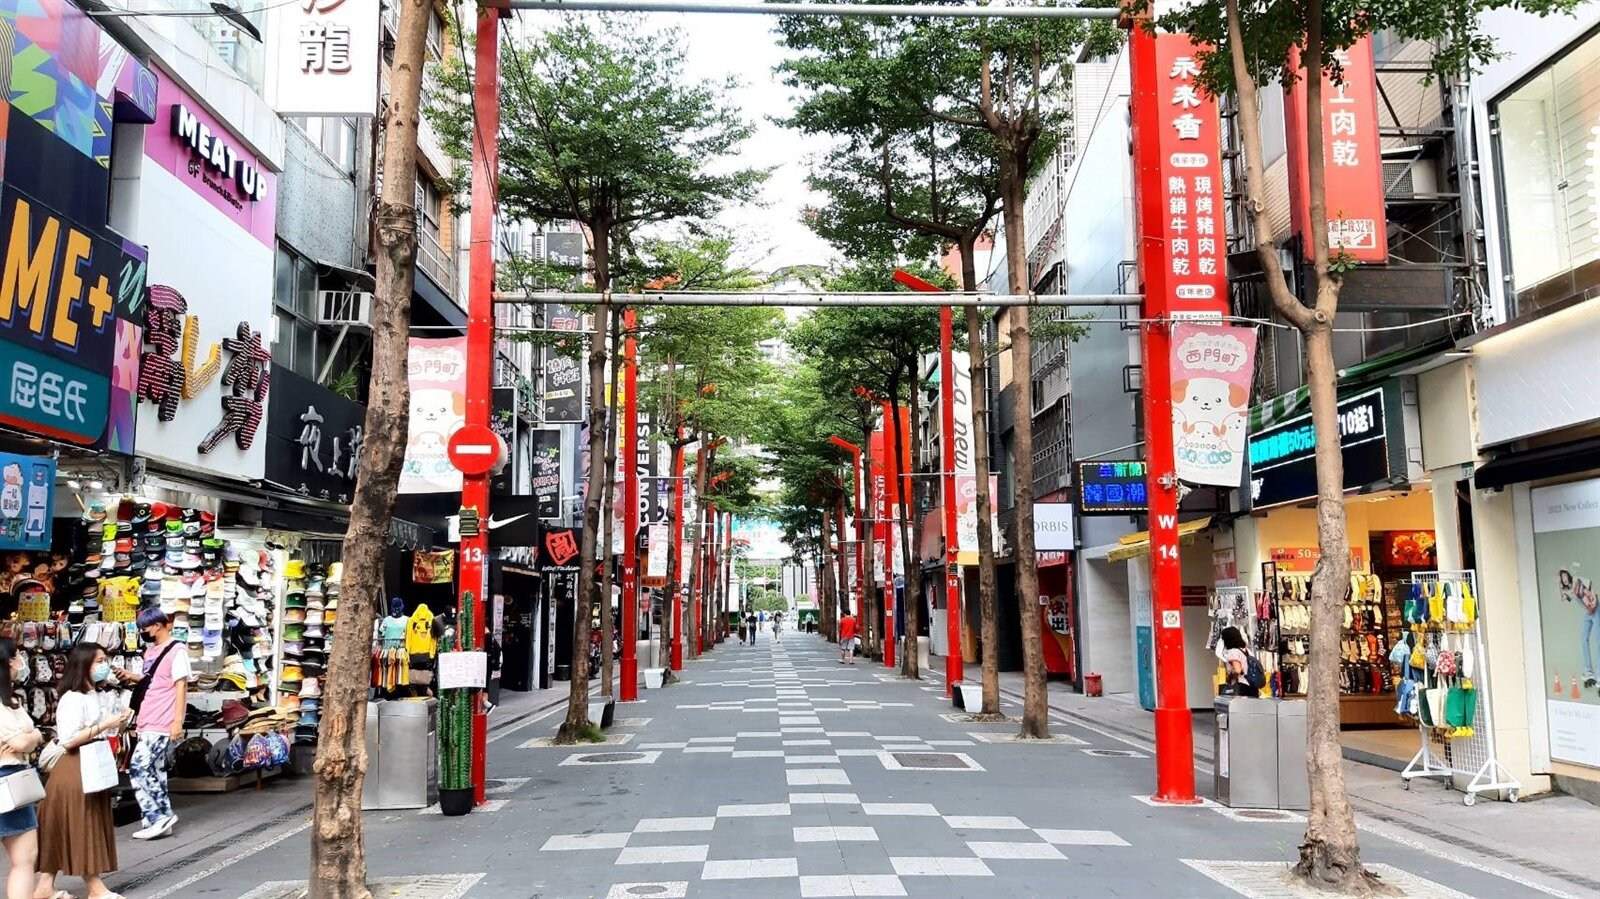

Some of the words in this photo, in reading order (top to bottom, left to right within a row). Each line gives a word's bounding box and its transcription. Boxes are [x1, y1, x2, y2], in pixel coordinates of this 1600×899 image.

[1169, 56, 1203, 140] 永來香
[177, 103, 238, 179] MEAT
[241, 160, 268, 201] UP
[1168, 176, 1191, 276] 熱銷牛肉乾
[1194, 176, 1217, 276] 現烤豬肉乾
[1186, 348, 1240, 366] 西門町
[10, 361, 88, 423] 屈臣氏
[636, 412, 650, 527] CONVERSE
[955, 418, 969, 470] new
[1158, 515, 1175, 529] W
[463, 547, 482, 562] 13
[624, 567, 633, 575] W
[1160, 545, 1178, 559] 14
